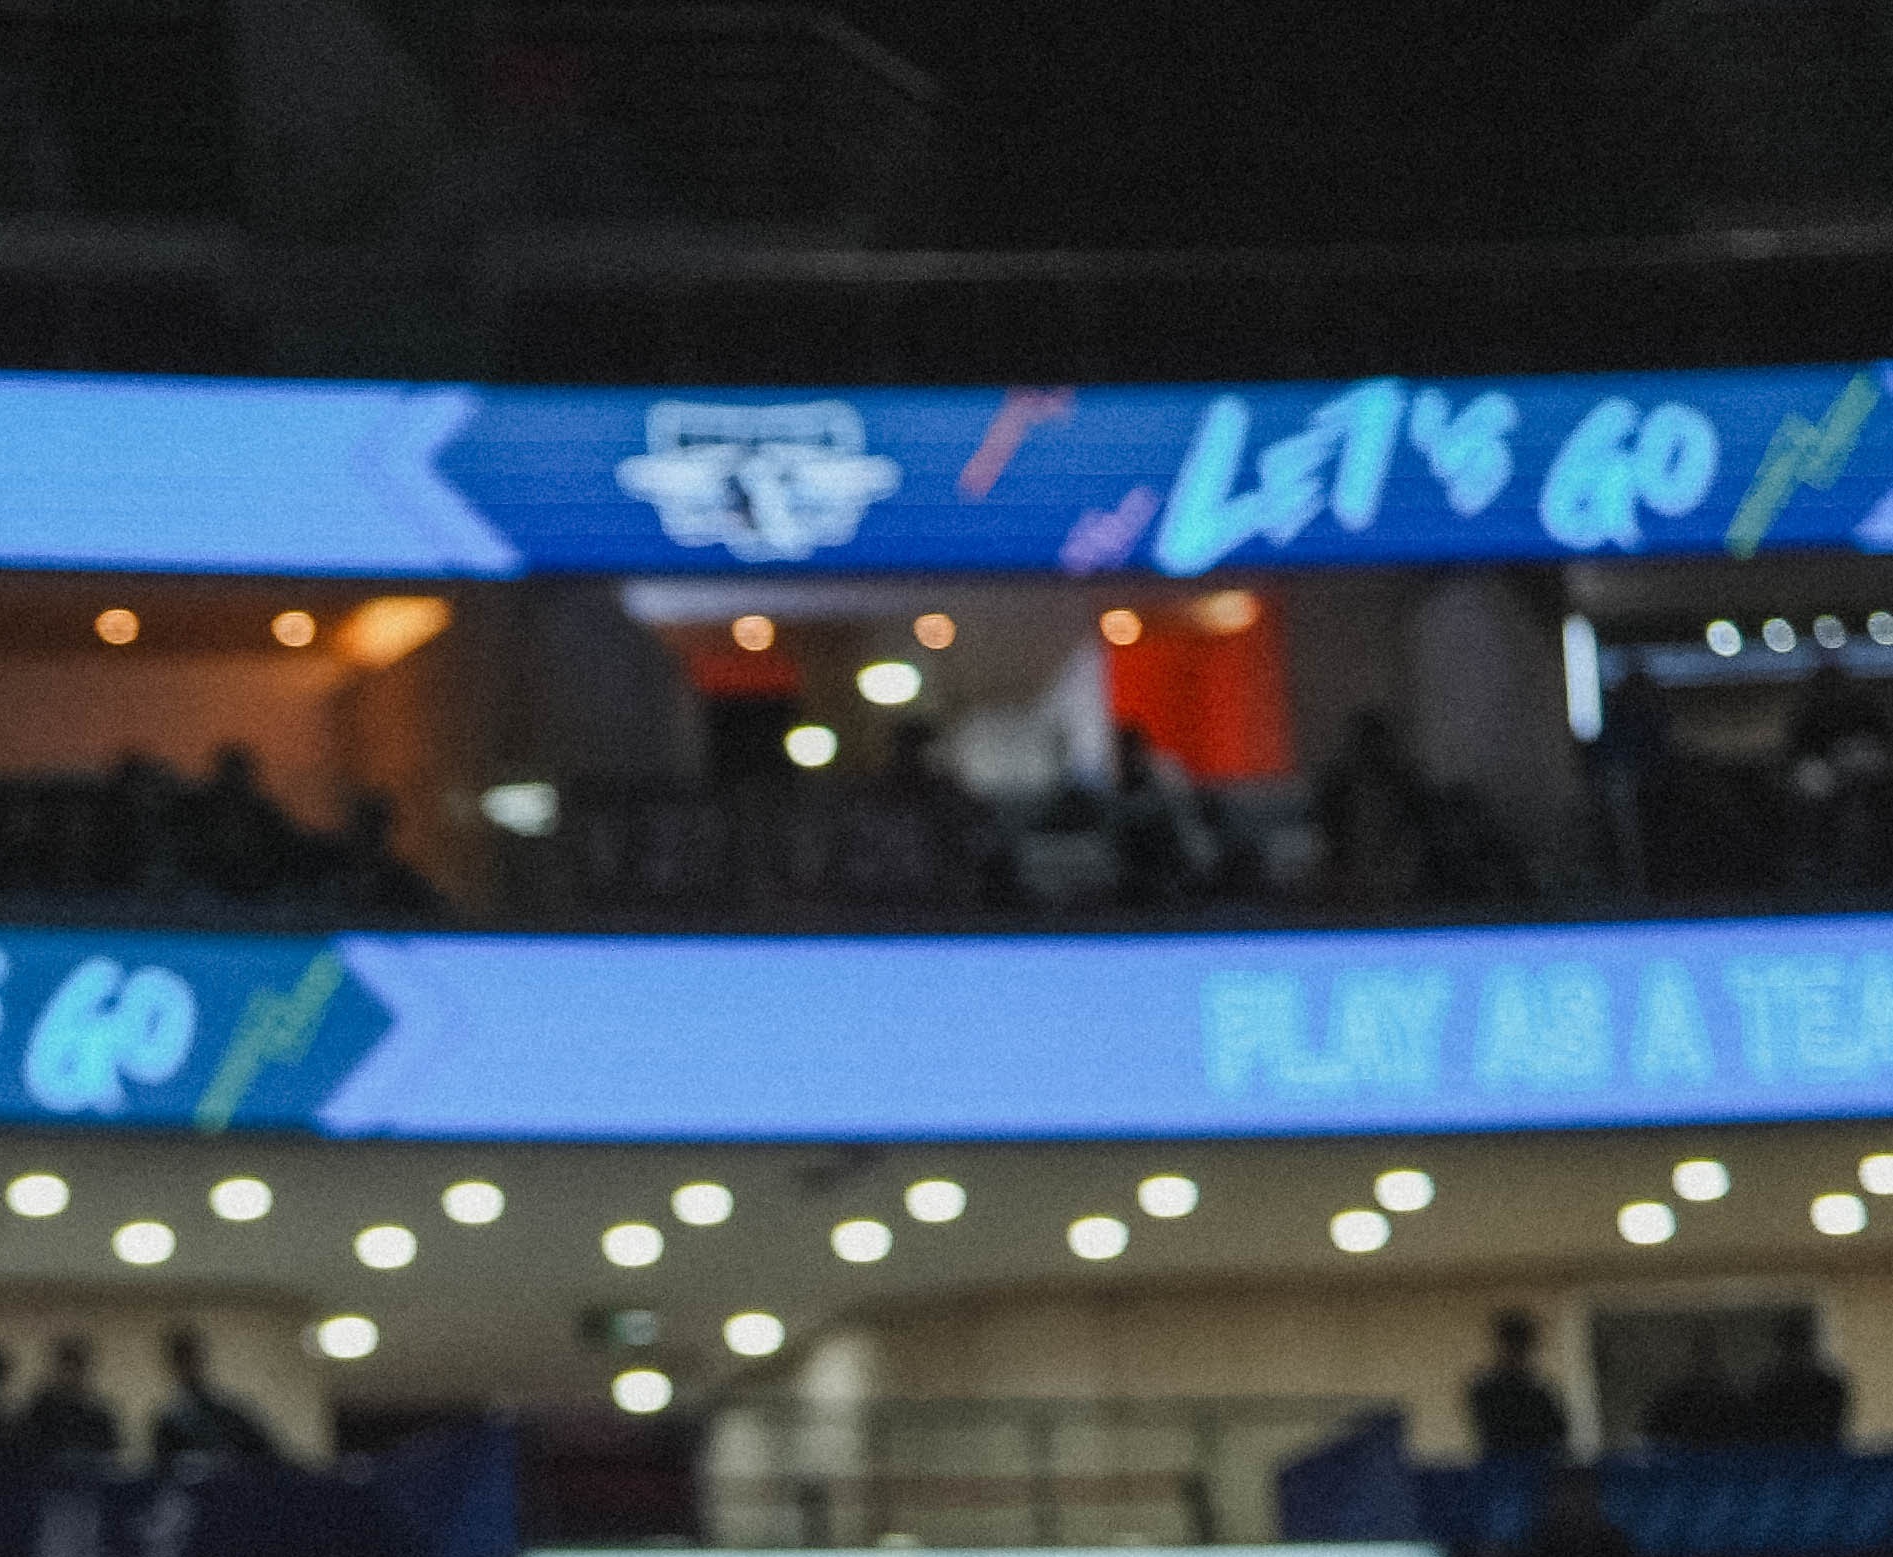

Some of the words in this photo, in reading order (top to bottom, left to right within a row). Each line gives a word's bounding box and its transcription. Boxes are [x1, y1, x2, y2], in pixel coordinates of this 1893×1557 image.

[1539, 399, 1717, 550] GO
[23, 956, 199, 1114] GO
[1200, 965, 1455, 1100] PLAY
[1633, 958, 1709, 1086] A
